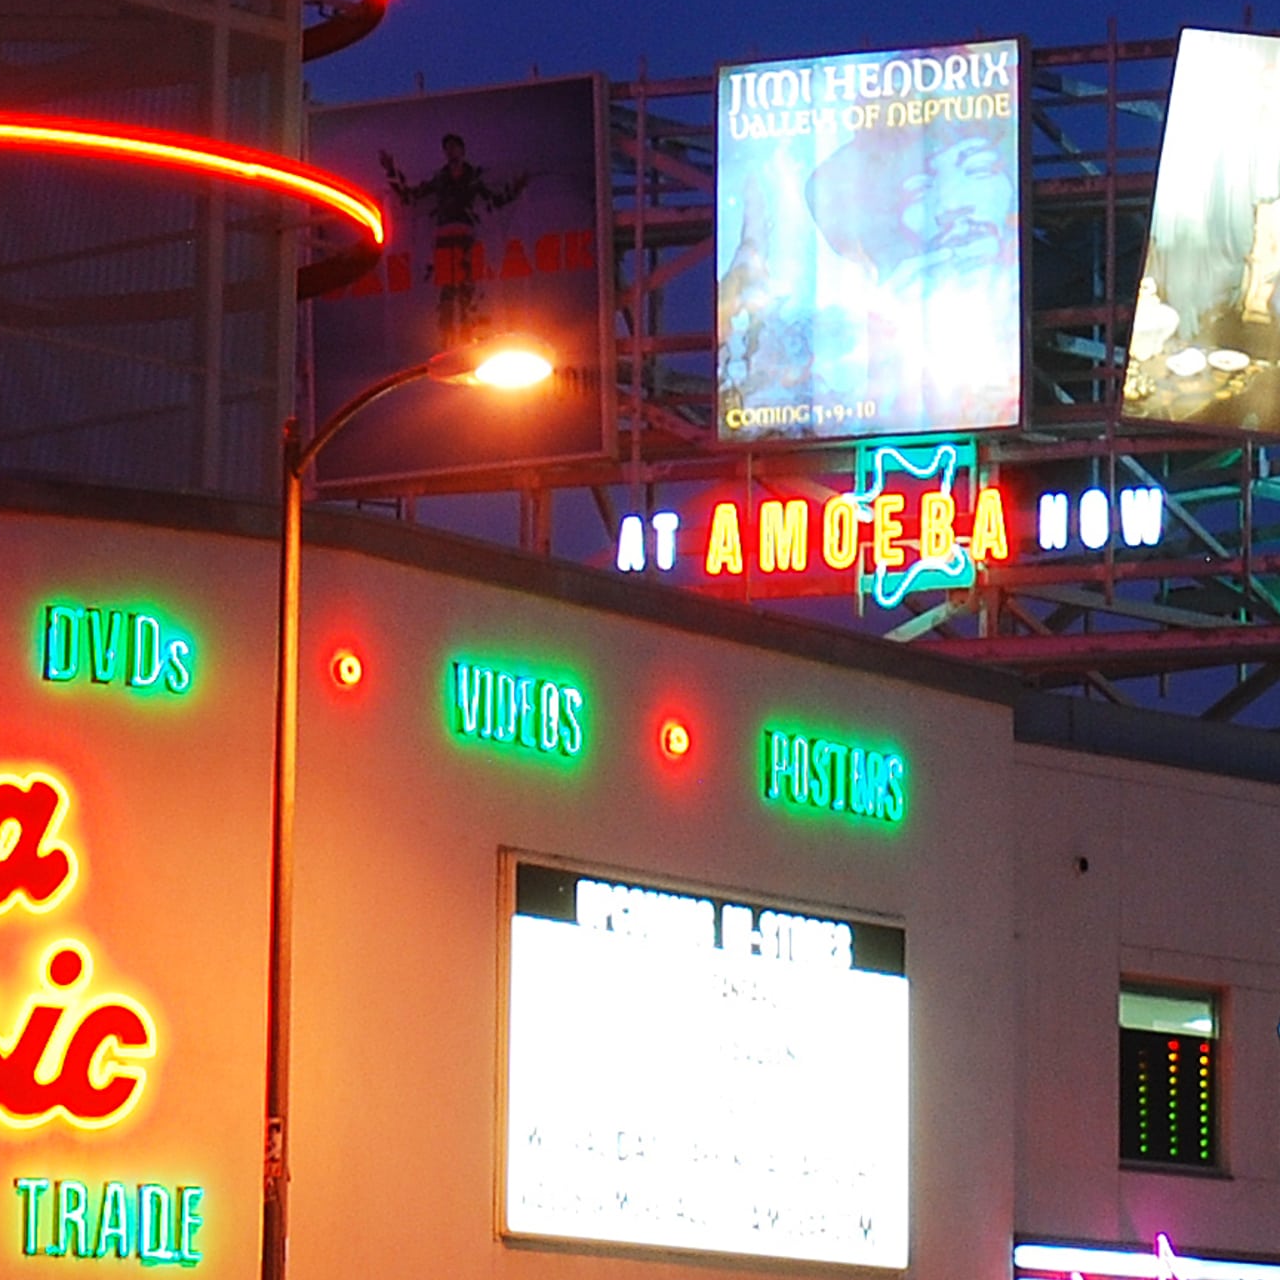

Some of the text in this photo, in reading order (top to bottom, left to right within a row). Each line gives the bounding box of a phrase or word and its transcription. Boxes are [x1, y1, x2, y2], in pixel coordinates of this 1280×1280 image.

[727, 51, 1010, 114] JIMI HENDRIX
[844, 104, 881, 131] OF
[886, 92, 1011, 129] NEPTUNE
[725, 403, 811, 430] COMING
[617, 486, 1164, 576] AT AMOEBA NOW
[41, 604, 195, 694] DVDs
[452, 661, 584, 757] VIDEOS
[763, 728, 905, 822] POSTERS
[14, 1176, 205, 1267] TRADE
